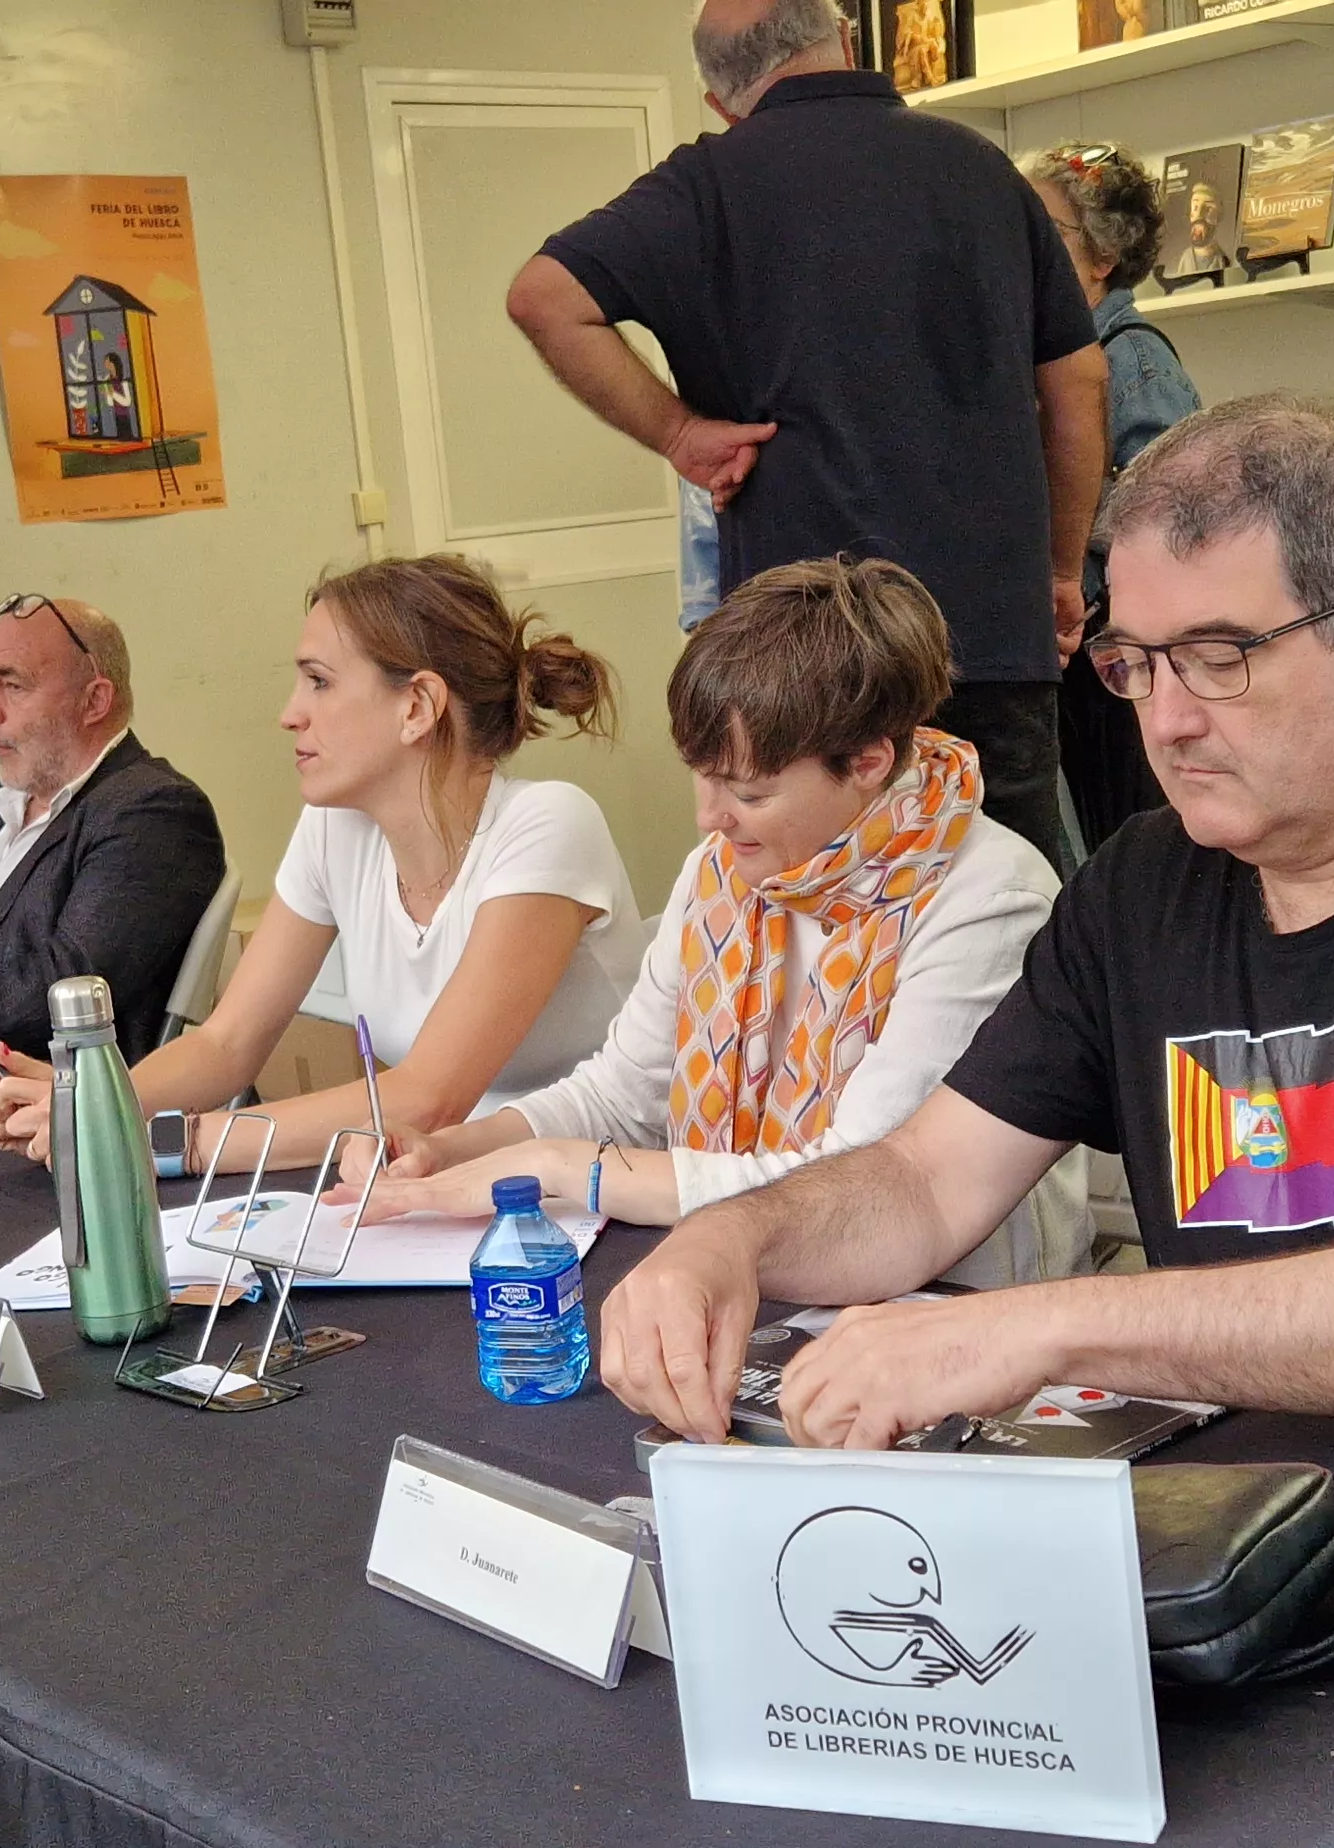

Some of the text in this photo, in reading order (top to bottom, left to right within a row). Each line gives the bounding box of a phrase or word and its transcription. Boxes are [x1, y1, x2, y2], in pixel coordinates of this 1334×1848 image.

[1204, 0, 1248, 20] RICARDO
[125, 204, 143, 214] DEL
[147, 203, 179, 214] LIBRO
[1248, 195, 1325, 219] Monegros
[123, 218, 181, 228] DE HUESCA
[500, 1286, 529, 1294] MONTE
[460, 1546, 519, 1585] D. Juanarete
[765, 1703, 1064, 1743] ASOCIACIÓN PROVINCIAL
[767, 1730, 1076, 1773] DE LIBRERIAS DE HUESCA
